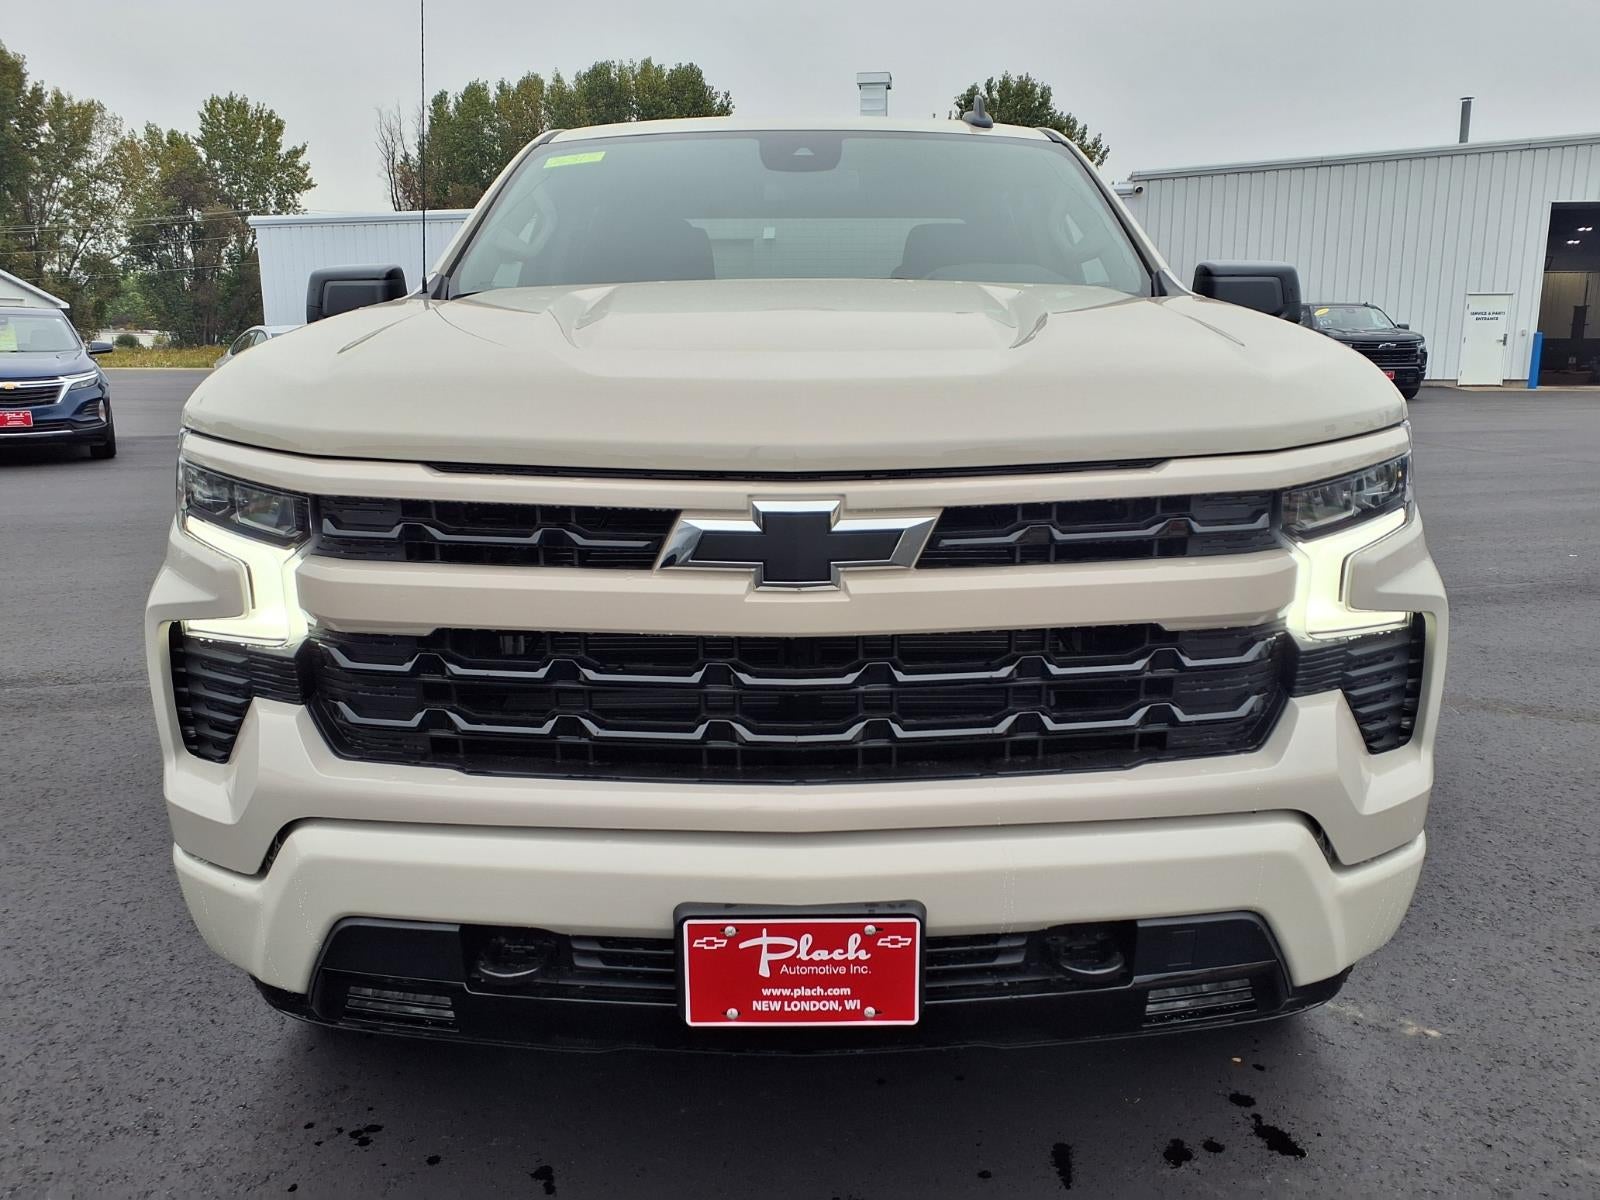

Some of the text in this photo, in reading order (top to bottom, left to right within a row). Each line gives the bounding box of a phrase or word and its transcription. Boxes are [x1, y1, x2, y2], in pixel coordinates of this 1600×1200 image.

[738, 927, 871, 978] Plach
[780, 963, 872, 975] Automotive Inc.
[761, 985, 851, 997] www.plach.com
[752, 999, 861, 1012] NEW LONDON, WI
